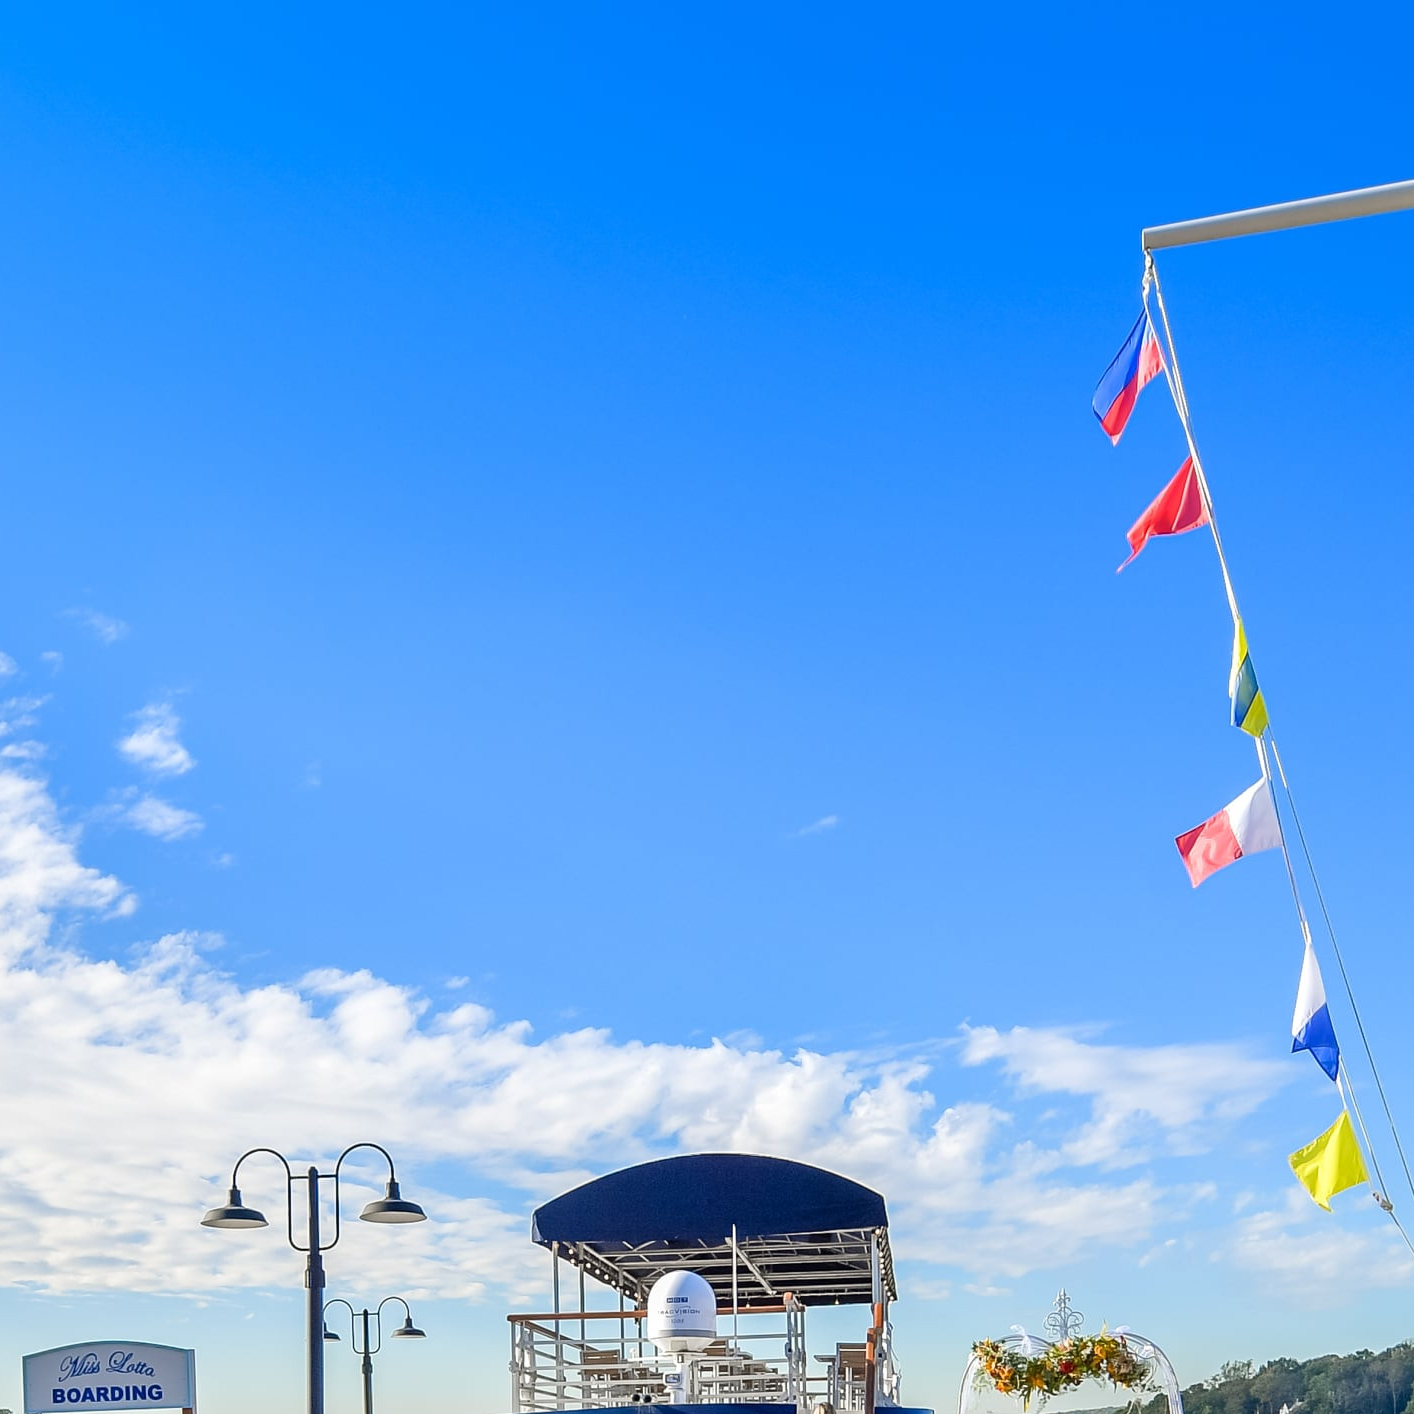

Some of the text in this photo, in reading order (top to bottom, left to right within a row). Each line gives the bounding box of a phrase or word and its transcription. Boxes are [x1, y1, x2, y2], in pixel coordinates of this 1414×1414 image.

[58, 1351, 155, 1382] Miss Lotta
[52, 1385, 163, 1403] BOARDING
